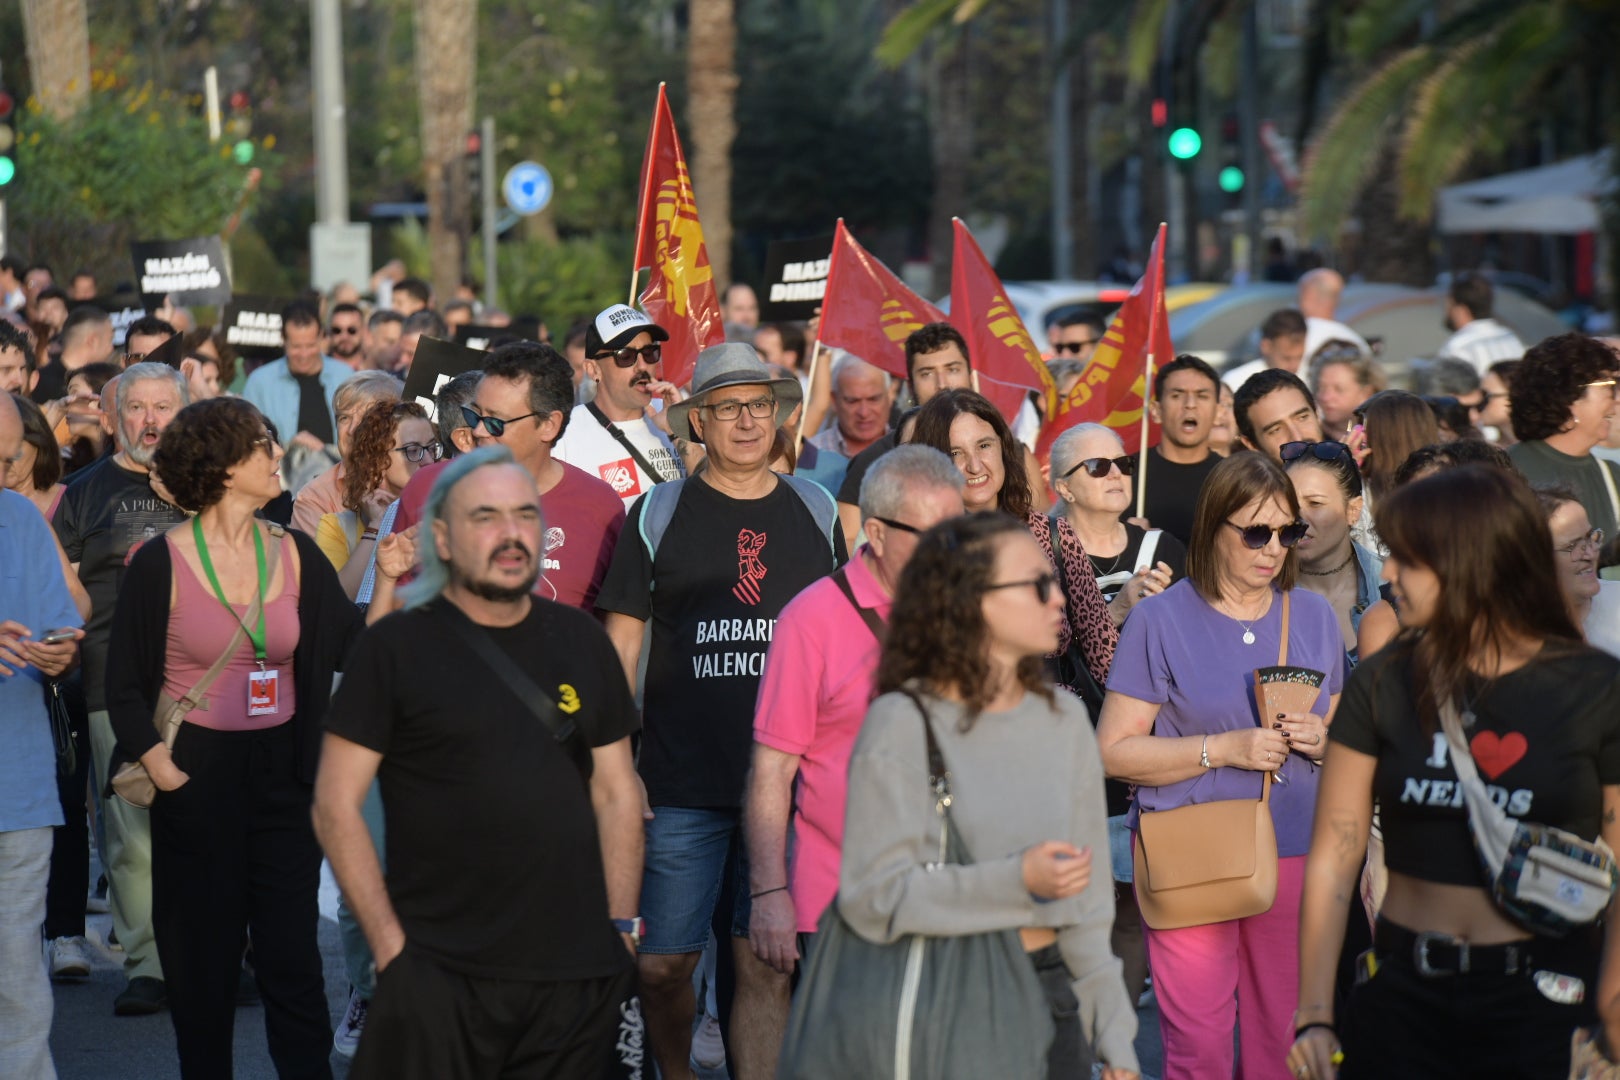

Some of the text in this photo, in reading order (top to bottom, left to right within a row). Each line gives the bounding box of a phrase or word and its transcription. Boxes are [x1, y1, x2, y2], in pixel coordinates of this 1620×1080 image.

[782, 253, 833, 283] MAZ
[769, 279, 829, 302] DIMIS
[236, 310, 284, 330] MAZ
[648, 447, 672, 460] SONS
[132, 498, 174, 512] PRES
[696, 618, 779, 645] BARBARI
[692, 651, 767, 679] VALENCI
